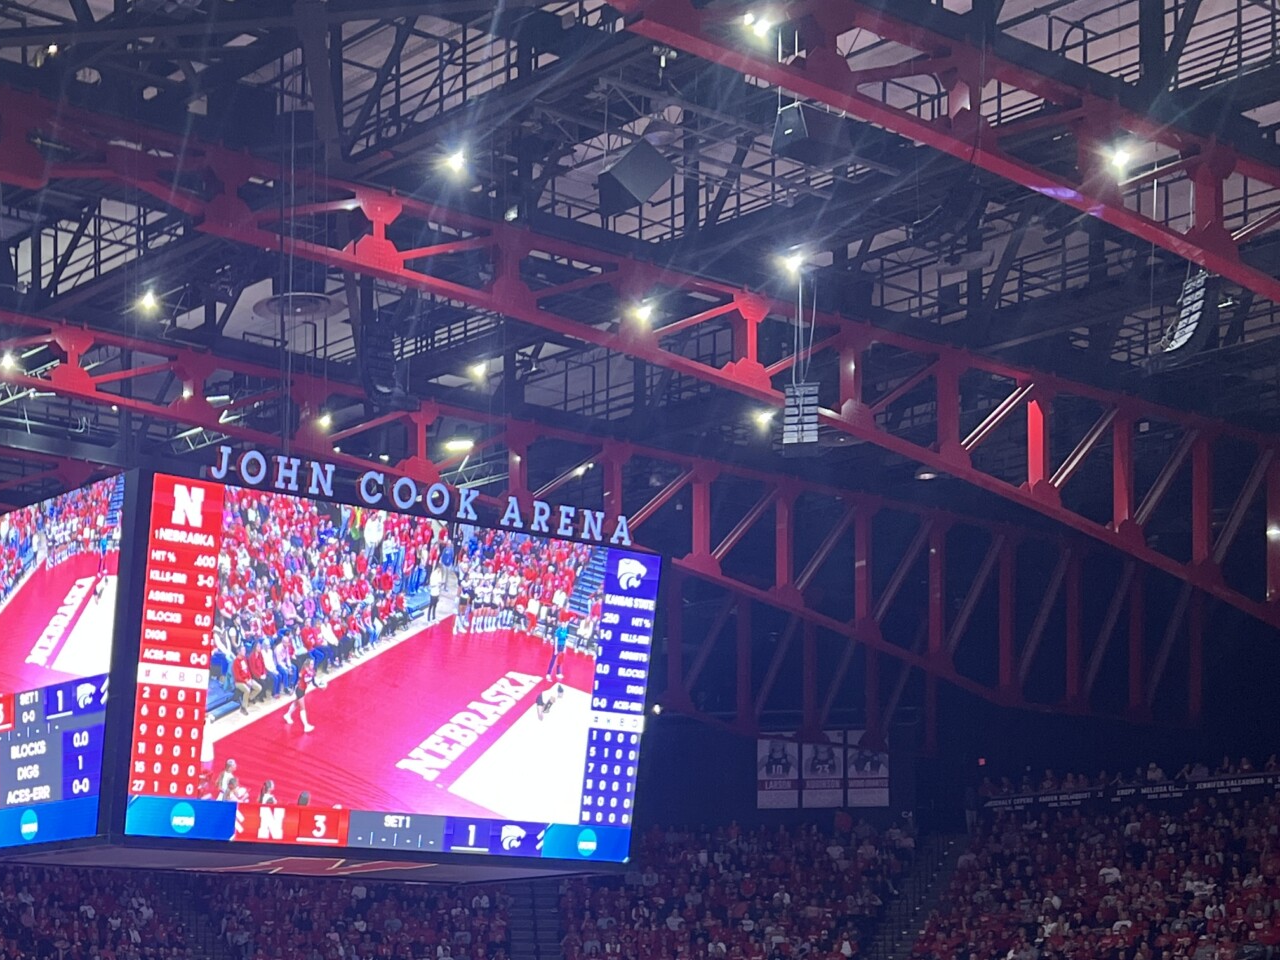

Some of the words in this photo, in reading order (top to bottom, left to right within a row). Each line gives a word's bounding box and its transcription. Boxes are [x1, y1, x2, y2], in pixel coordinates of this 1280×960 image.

[171, 483, 205, 528] N
[211, 445, 336, 497] JOHN
[359, 470, 480, 520] COOK
[502, 496, 632, 547] ARENA
[159, 527, 215, 547] NEBRASKA
[24, 575, 96, 667] NEBRASKA
[19, 692, 34, 706] SET
[57, 690, 63, 712] 1
[395, 671, 544, 782] NEBRASKA
[10, 740, 46, 760] BLOCKS
[17, 764, 40, 781] DIGS
[6, 785, 51, 805] ACES-ERR
[257, 807, 285, 839] N
[312, 814, 326, 838] 3
[384, 814, 404, 828] SET
[468, 824, 476, 846] 1
